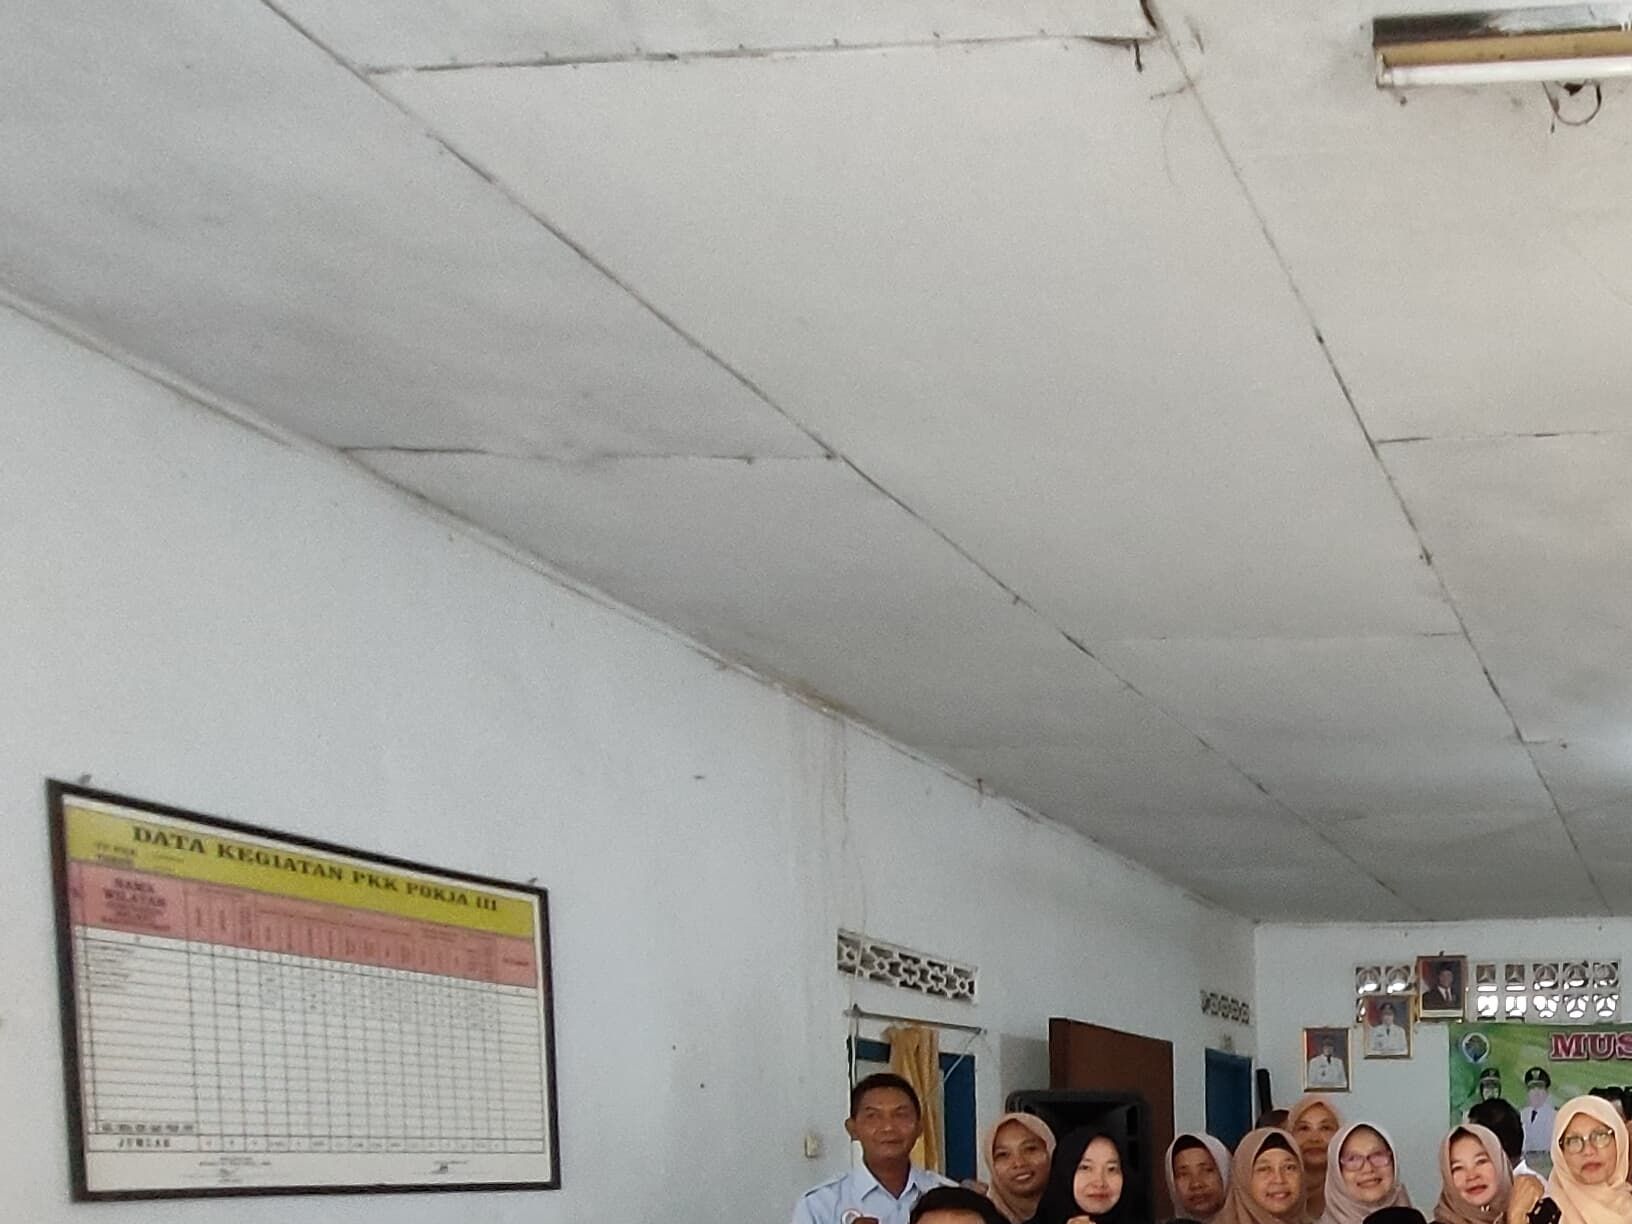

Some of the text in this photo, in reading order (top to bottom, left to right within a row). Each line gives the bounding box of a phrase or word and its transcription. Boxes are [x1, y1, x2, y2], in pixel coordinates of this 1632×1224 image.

[133, 827, 205, 854] DATA
[218, 843, 342, 882] KEGIATAN
[353, 871, 398, 892] PKK
[406, 883, 468, 908] POKJA
[476, 897, 497, 911] III
